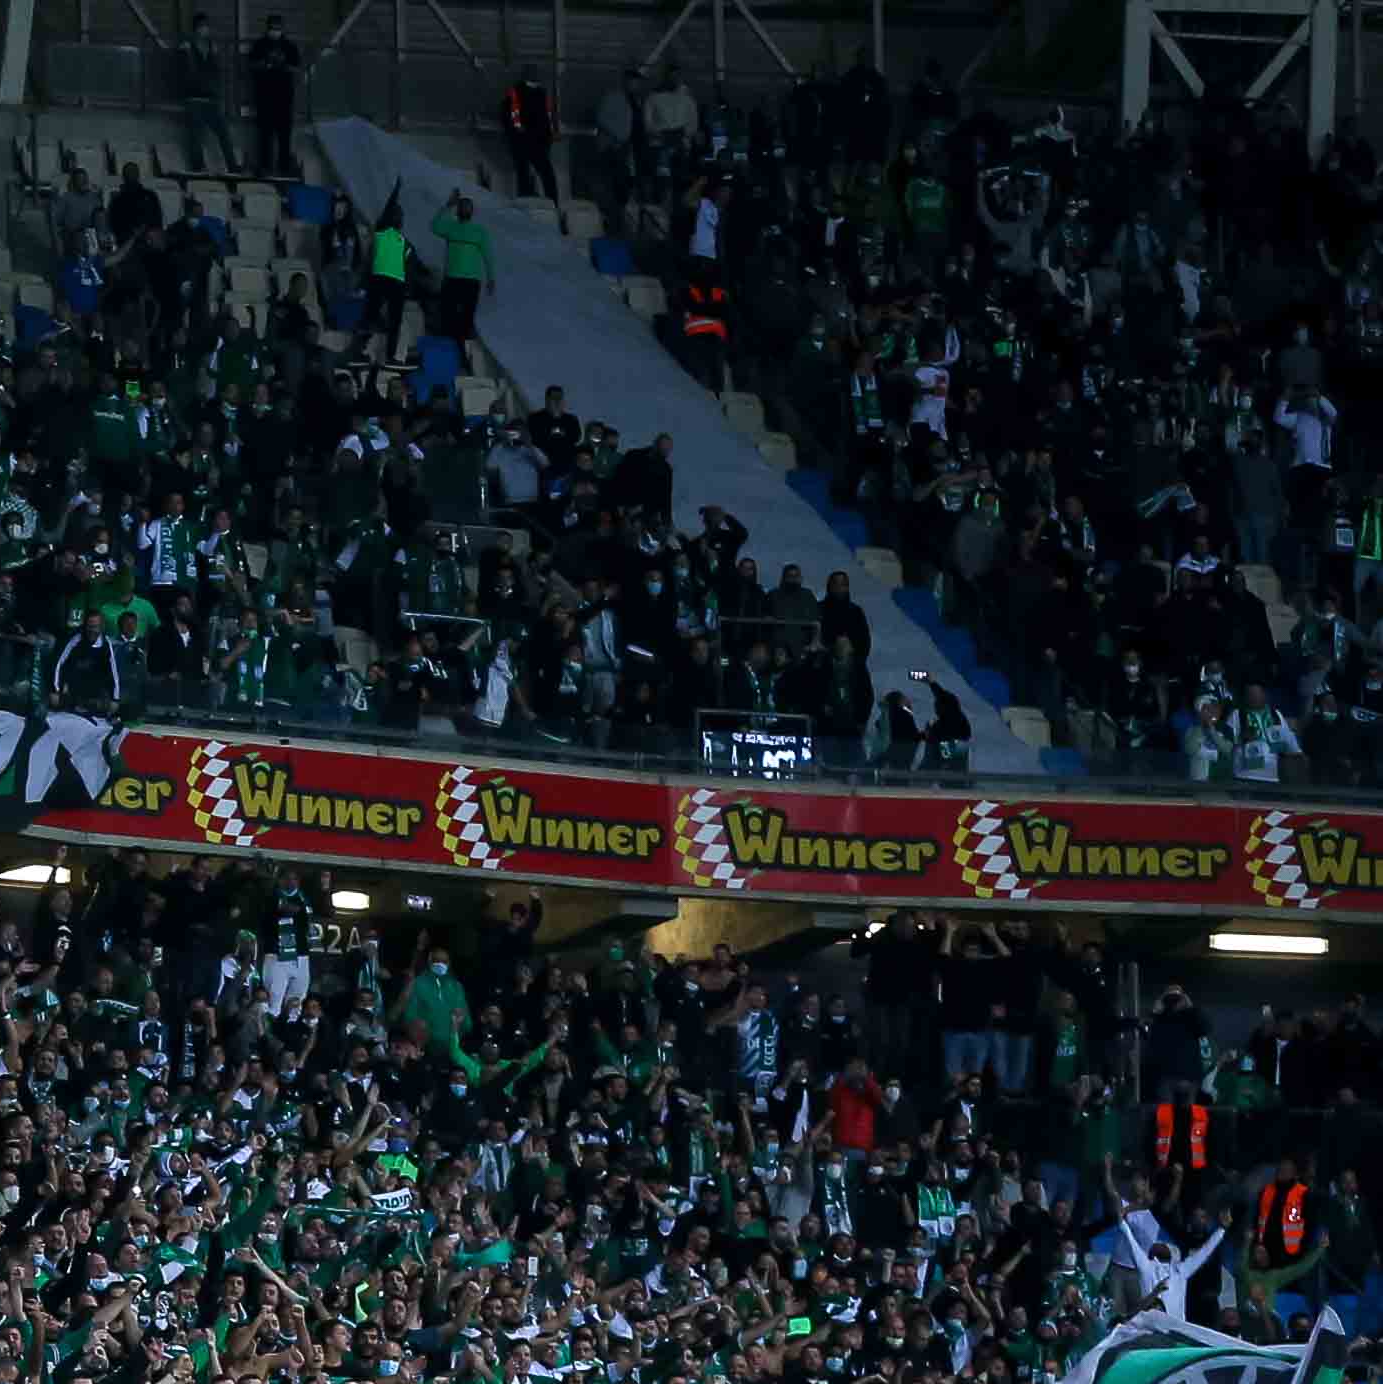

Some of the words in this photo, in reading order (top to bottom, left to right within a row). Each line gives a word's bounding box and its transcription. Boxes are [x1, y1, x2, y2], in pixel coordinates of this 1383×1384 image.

[235, 763, 421, 836] Winner
[481, 786, 660, 857] Winner
[727, 805, 936, 872] Winner
[1008, 815, 1228, 877] Winner
